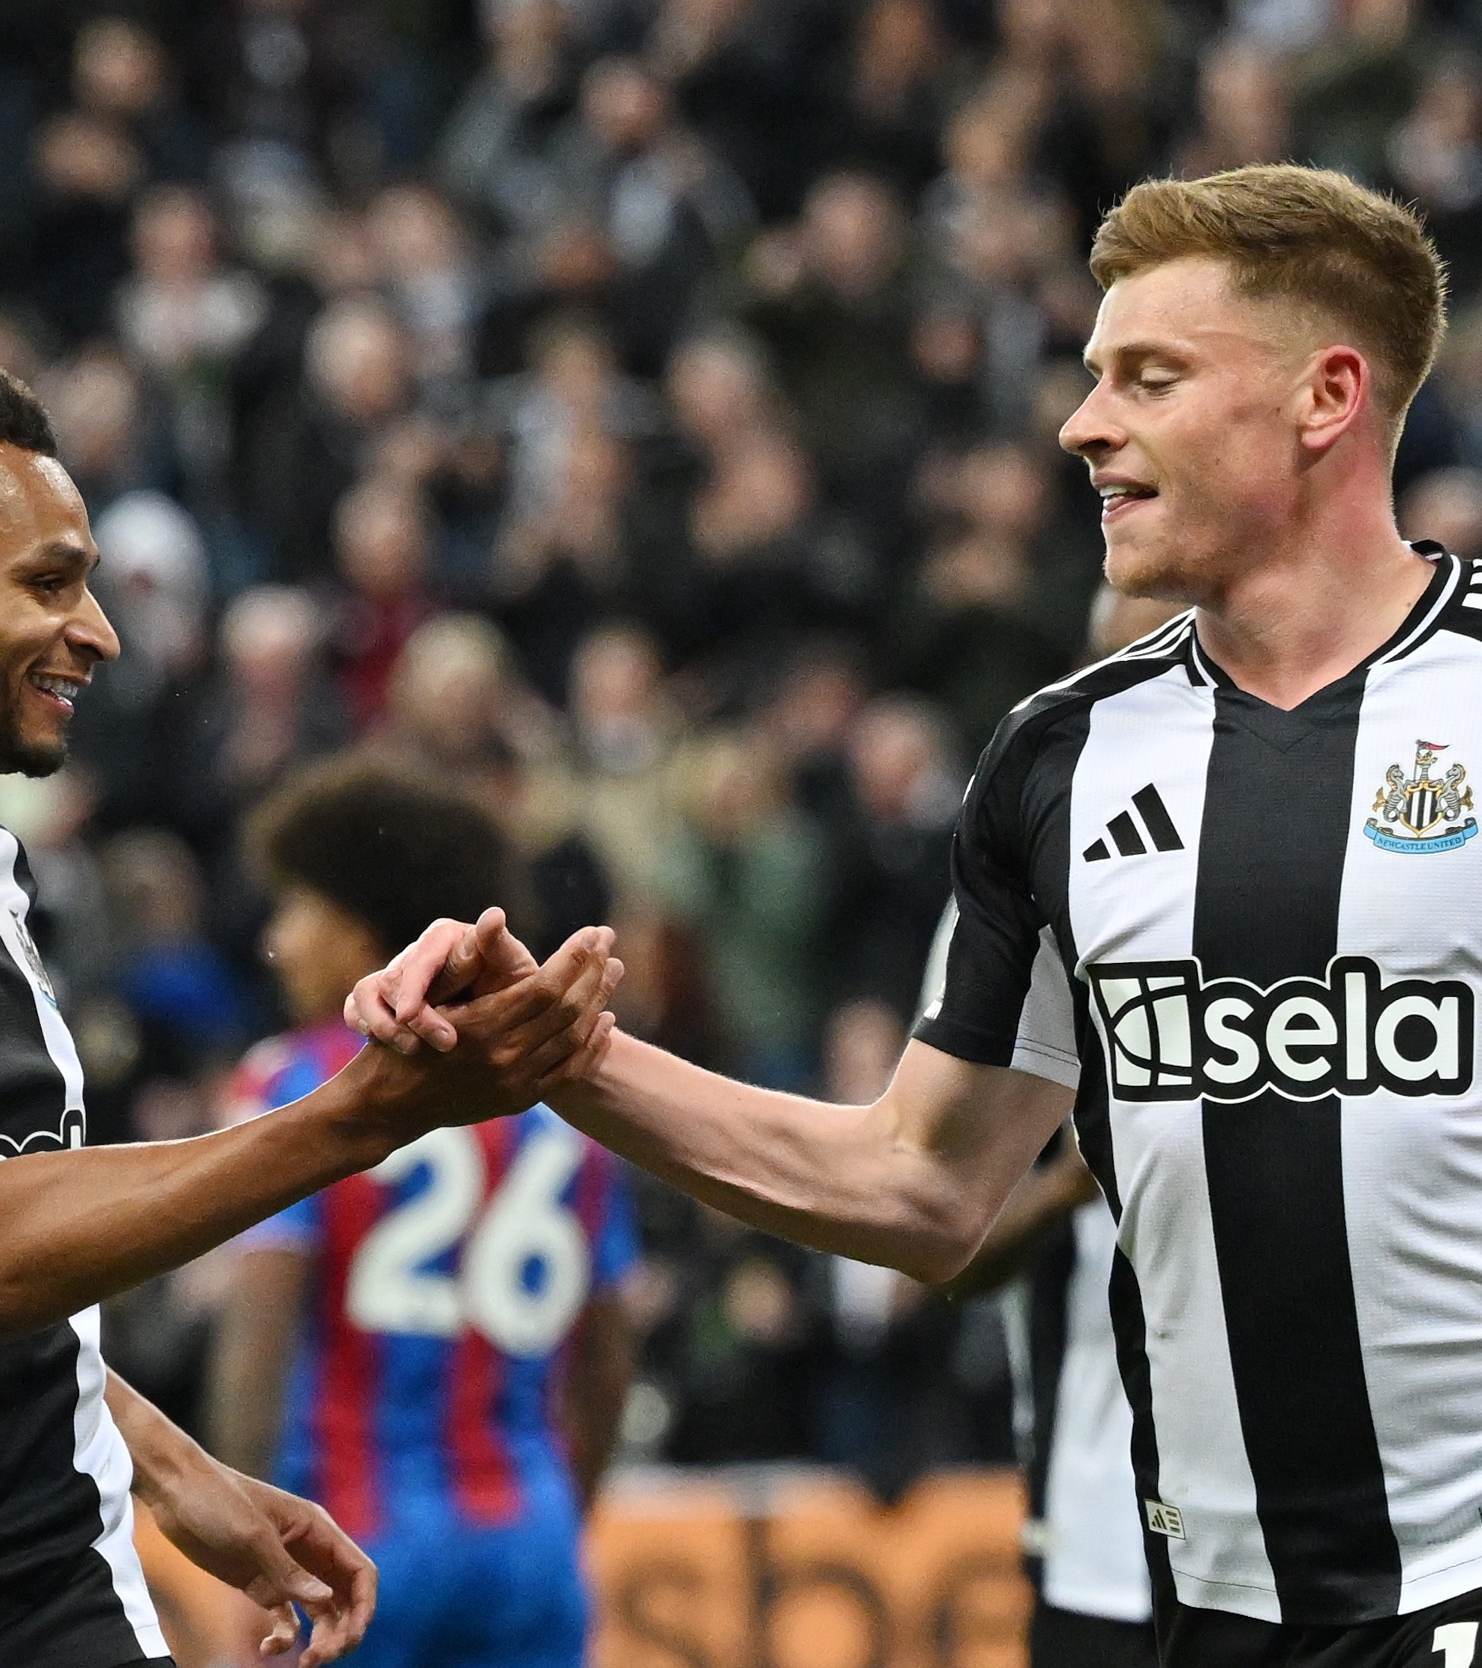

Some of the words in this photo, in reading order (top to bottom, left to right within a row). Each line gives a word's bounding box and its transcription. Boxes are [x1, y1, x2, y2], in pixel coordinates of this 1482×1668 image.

[1376, 837, 1427, 851] NEWCASTLE
[1428, 836, 1462, 850] UNITED
[1202, 971, 1460, 1084] sela
[345, 1126, 593, 1358] 26
